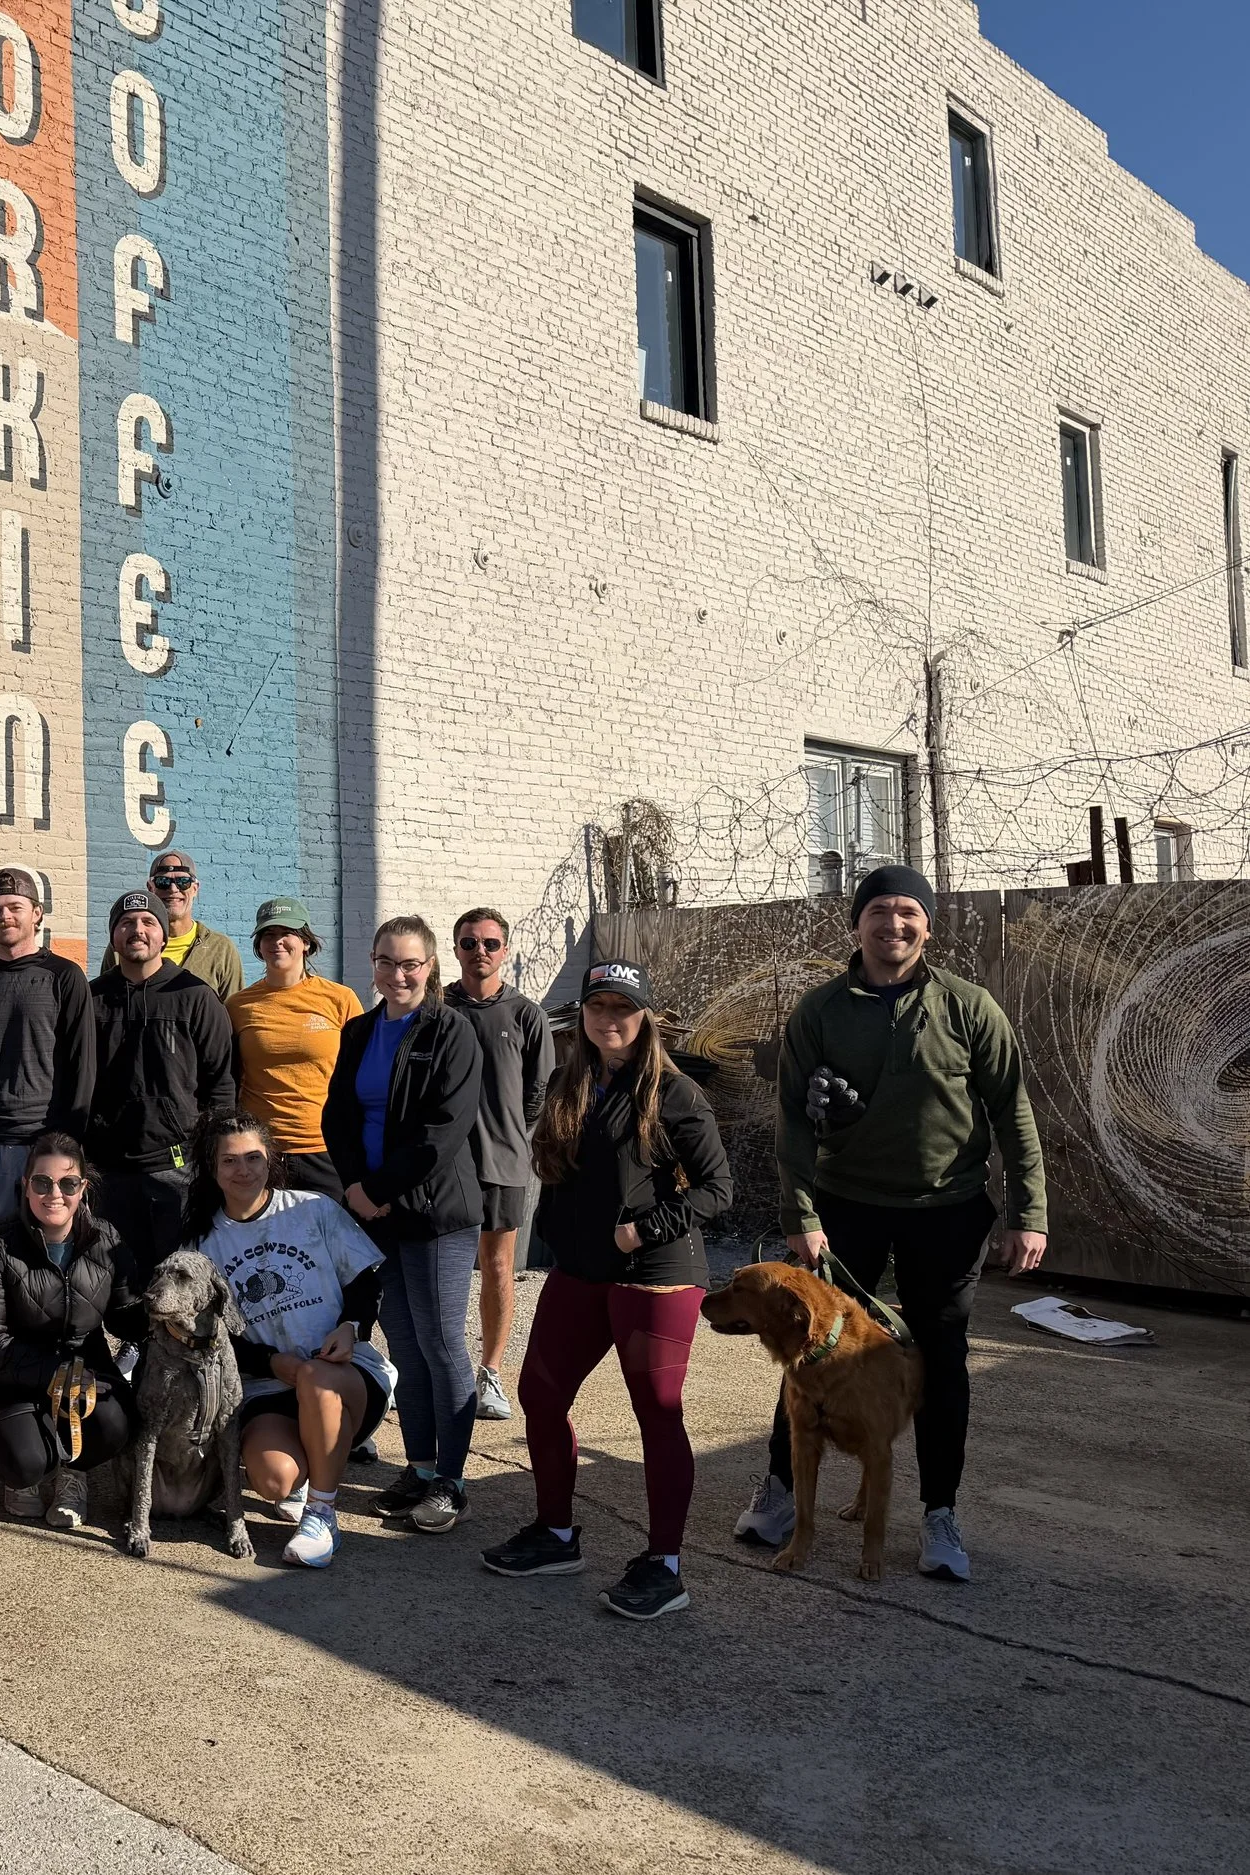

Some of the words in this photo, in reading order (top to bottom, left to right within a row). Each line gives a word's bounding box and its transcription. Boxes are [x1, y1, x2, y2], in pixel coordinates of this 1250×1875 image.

[110, 0, 174, 849] OFFEE
[604, 964, 640, 983] KMC
[224, 1255, 244, 1278] AL
[243, 1242, 316, 1271] COWBOYS
[294, 1296, 323, 1310] FOLKS
